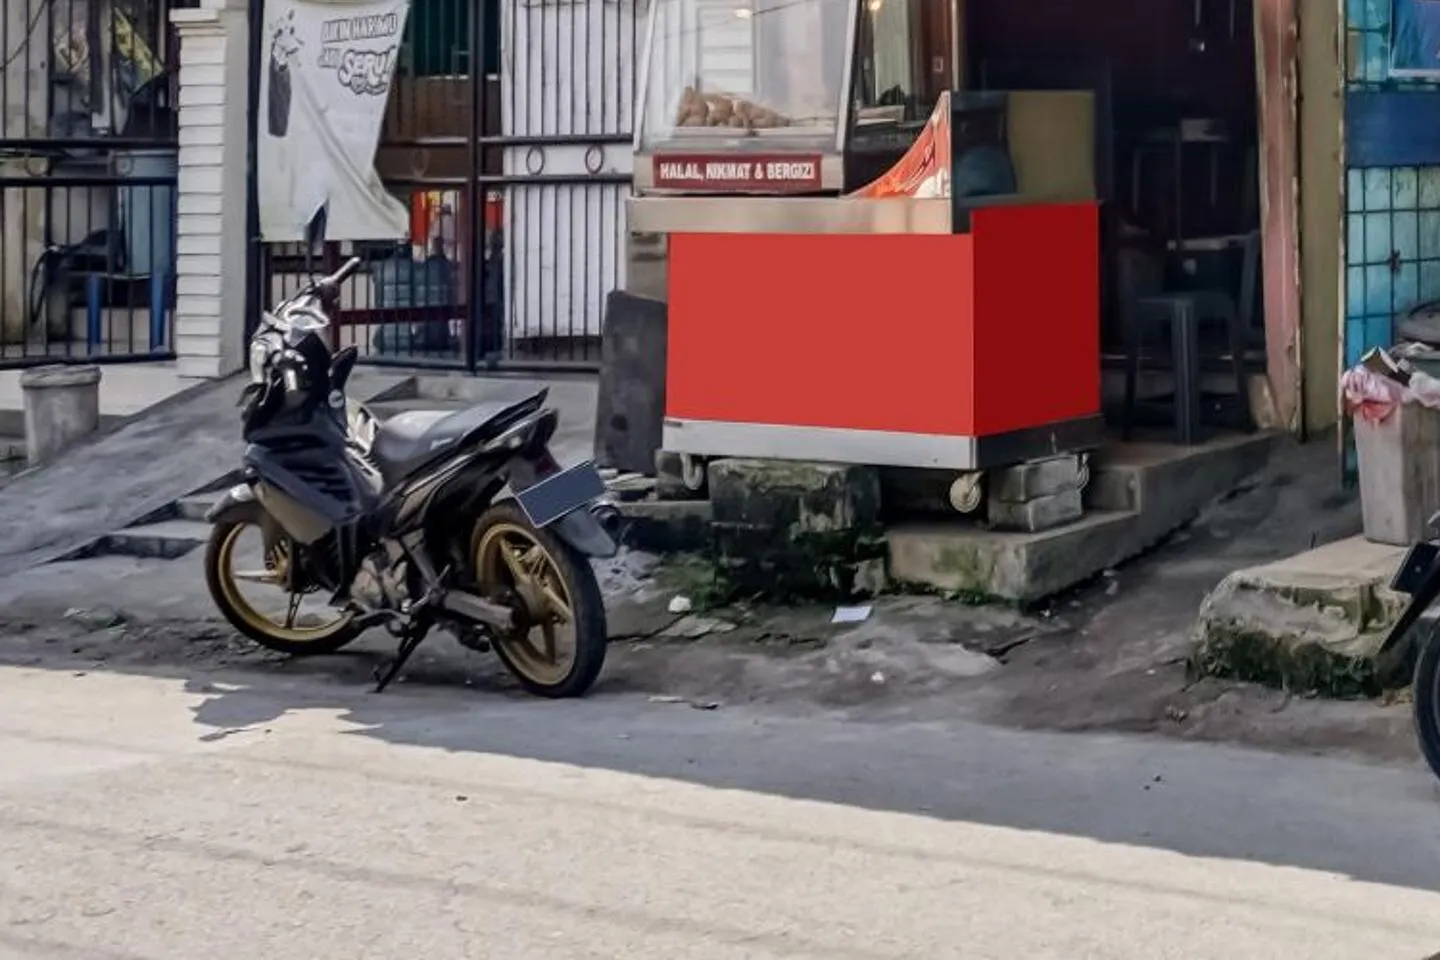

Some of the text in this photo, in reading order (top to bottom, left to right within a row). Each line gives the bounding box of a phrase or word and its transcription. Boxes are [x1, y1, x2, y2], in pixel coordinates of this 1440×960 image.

[659, 162, 704, 181] HALAL,
[706, 162, 751, 180] NIKMAT
[767, 162, 815, 180] BERGIZI
